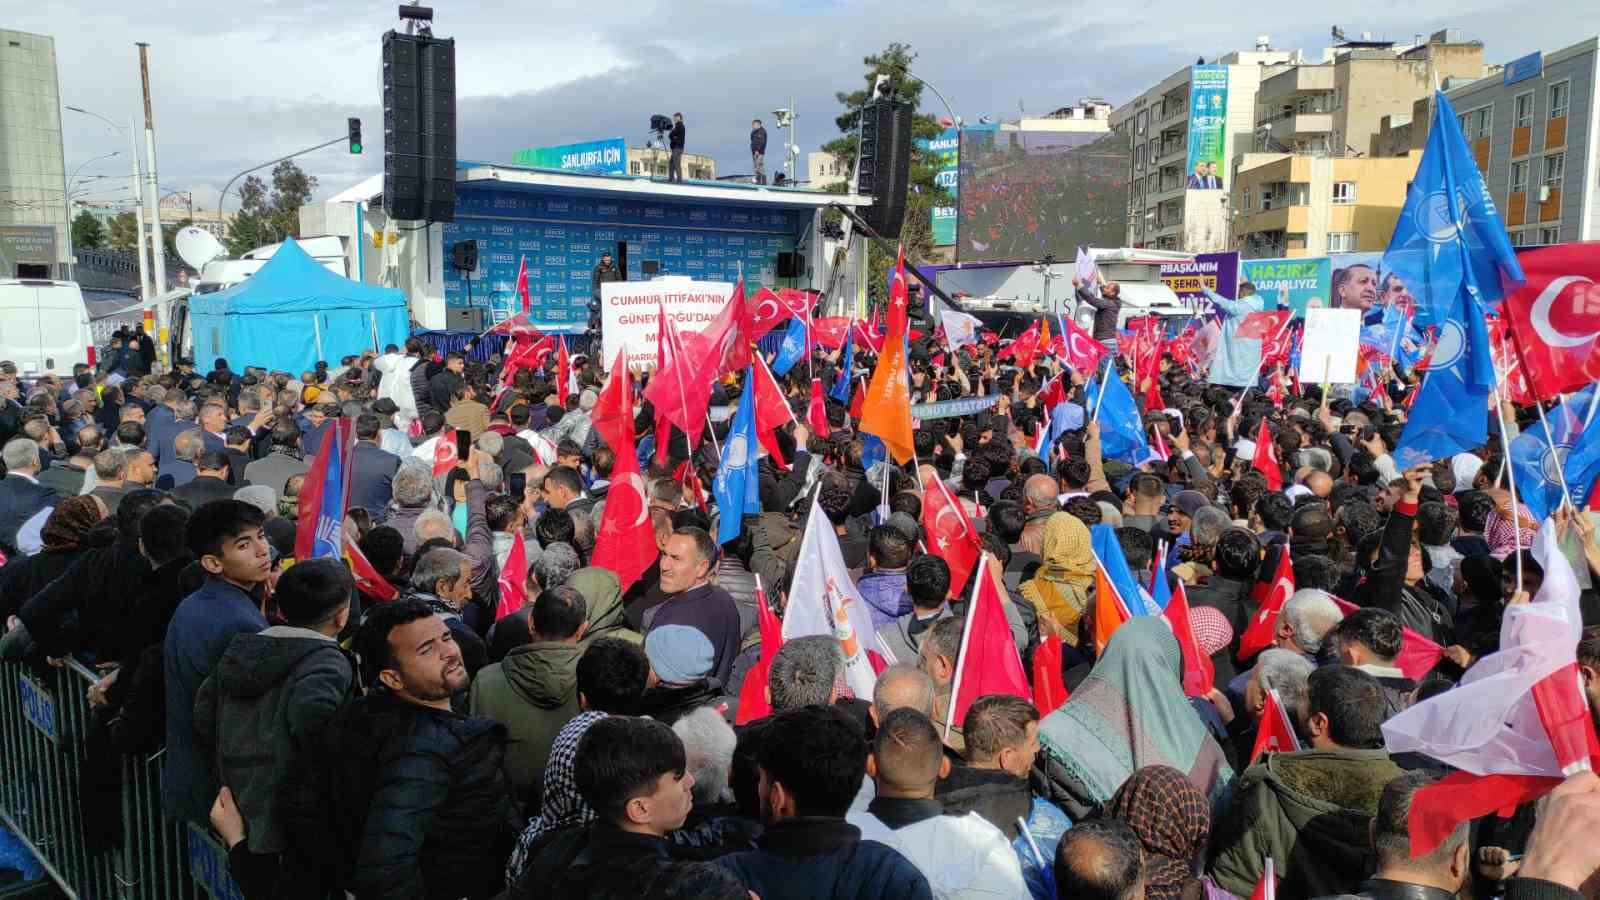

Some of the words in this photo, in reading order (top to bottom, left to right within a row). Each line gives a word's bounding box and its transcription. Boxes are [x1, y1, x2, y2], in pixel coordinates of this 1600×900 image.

[1161, 262, 1218, 273] RBAŞKANIM
[1174, 279, 1215, 290] ŞEHRNE
[610, 295, 660, 306] CUMHUR
[619, 311, 720, 325] GÜNEYOĞU'DAK
[626, 353, 659, 361] HARRA
